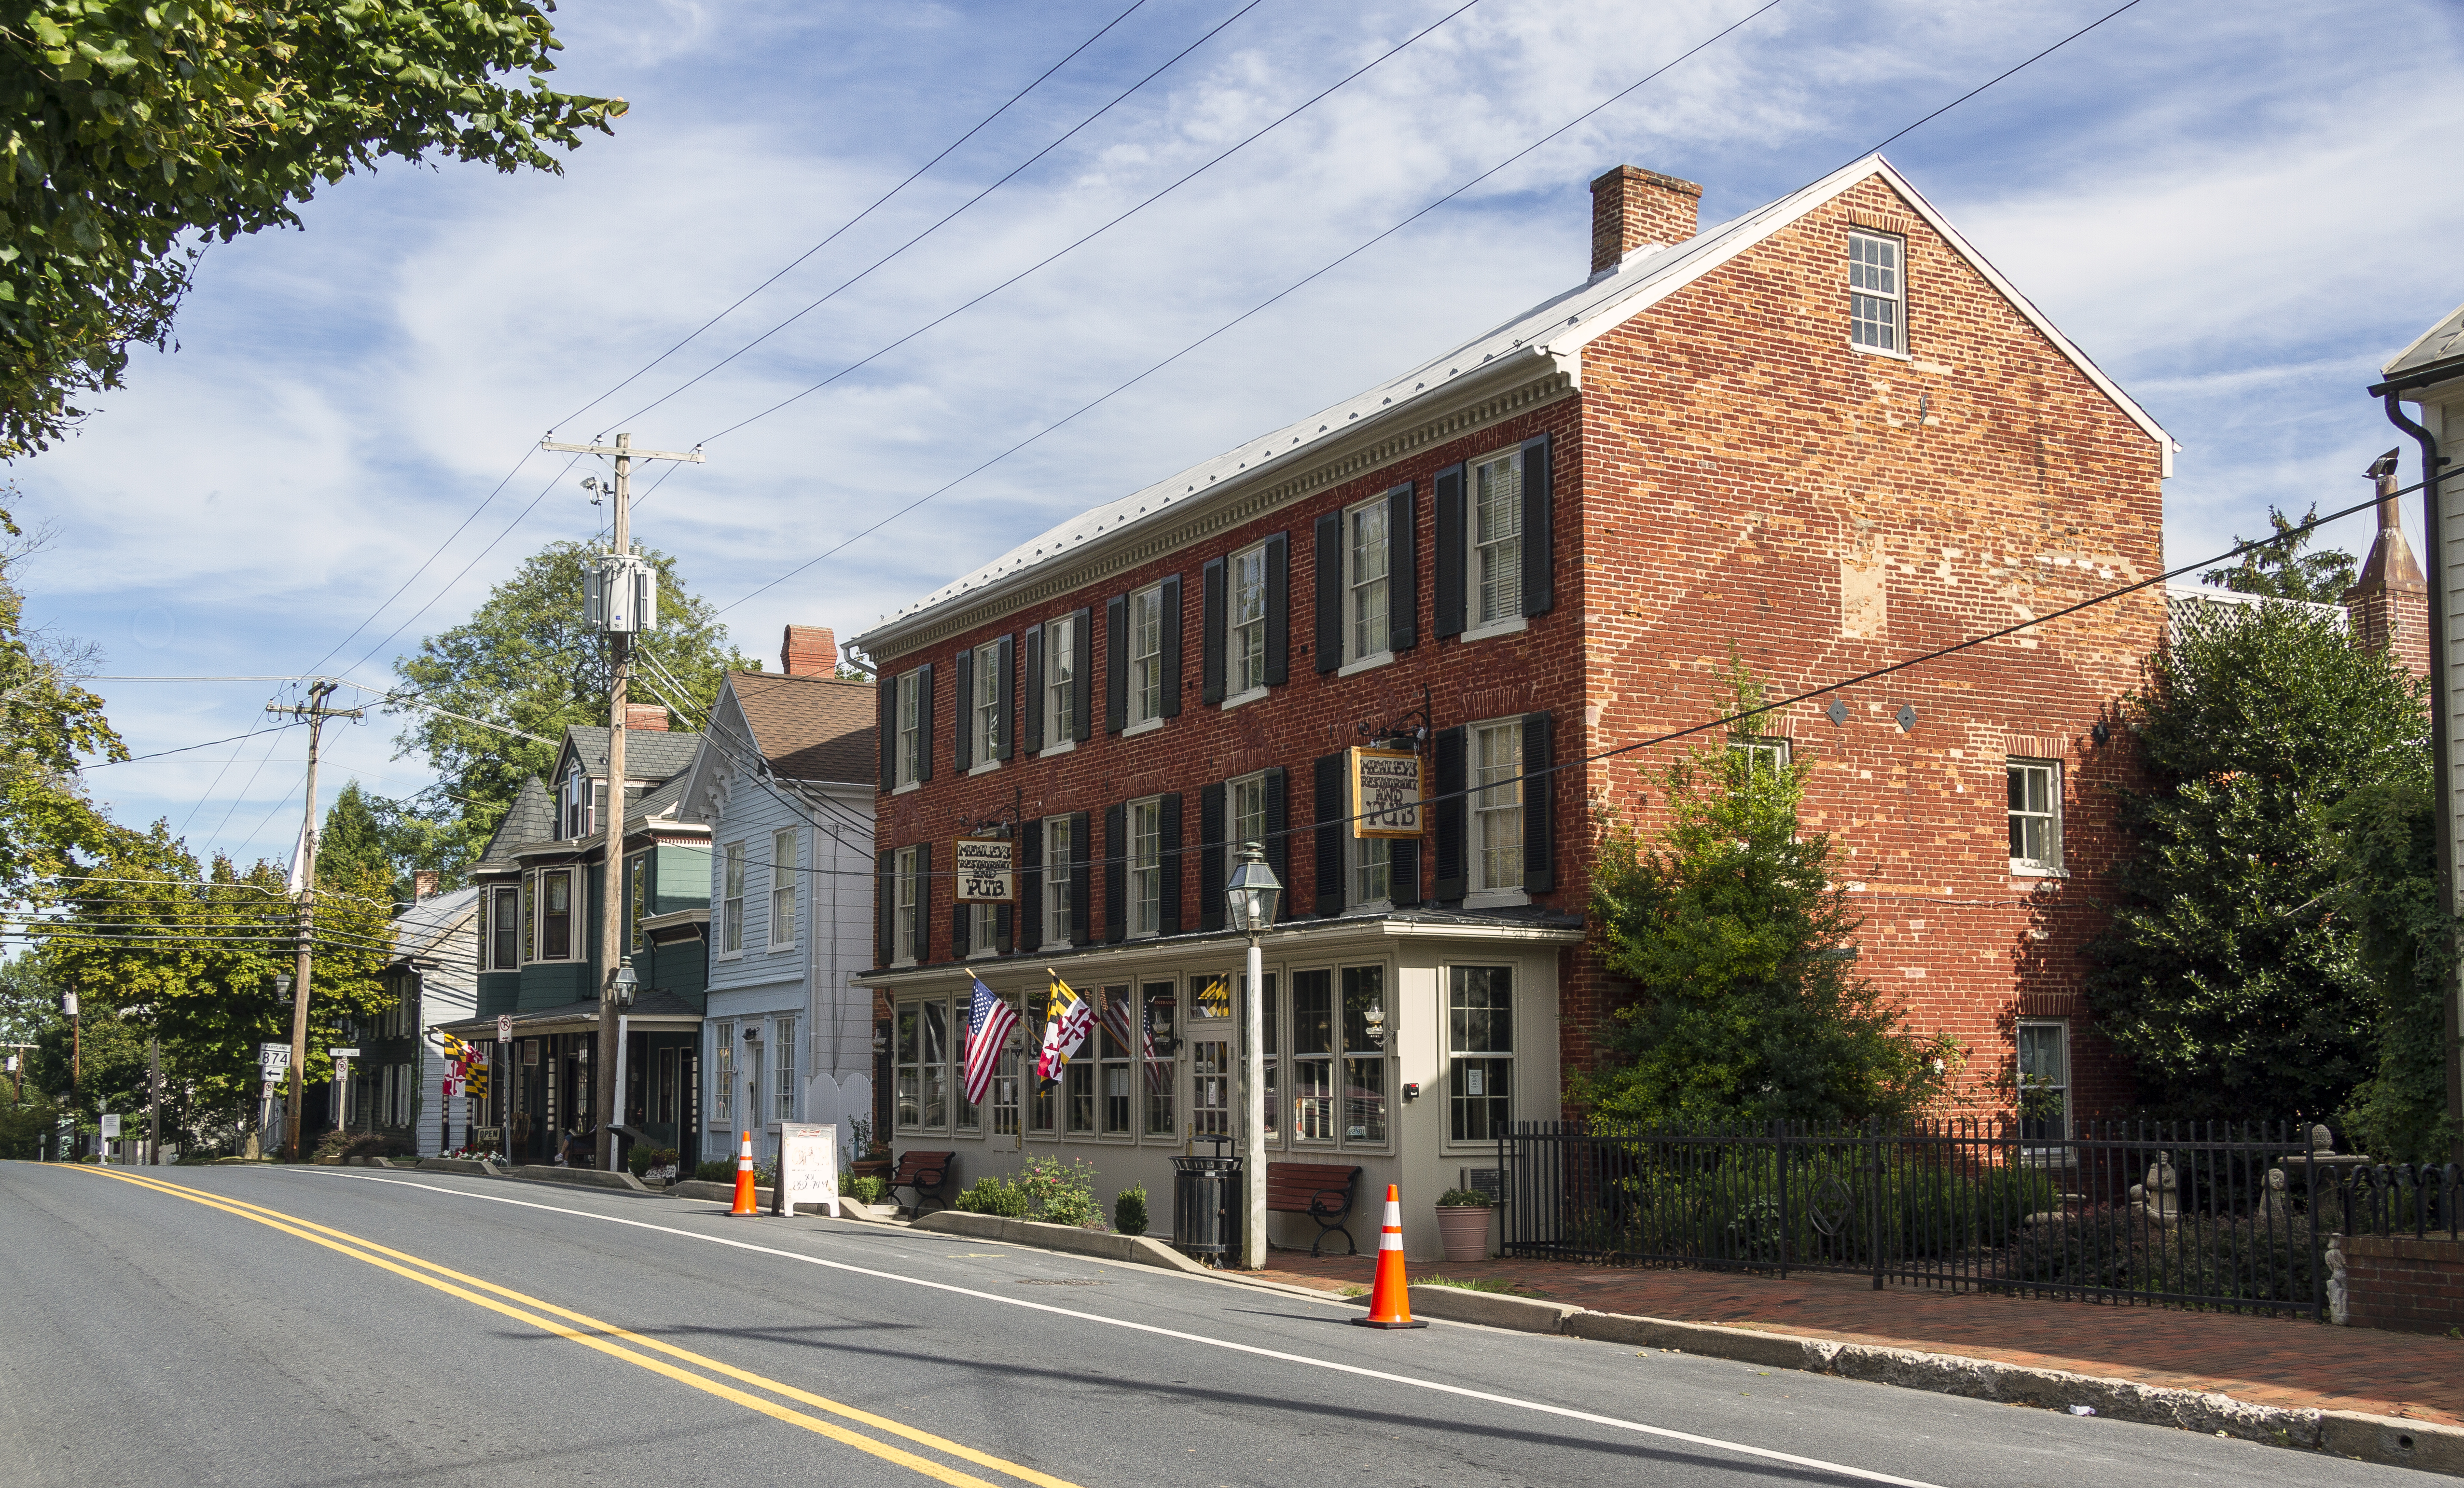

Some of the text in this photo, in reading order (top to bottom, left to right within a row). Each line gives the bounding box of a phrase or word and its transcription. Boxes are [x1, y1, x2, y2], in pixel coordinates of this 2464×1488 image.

[1361, 775, 1418, 791] RESTAURANT
[1375, 788, 1403, 803] AND
[1366, 800, 1415, 827] PUB
[958, 859, 1011, 869] RESTAURANT
[973, 868, 997, 879] AND
[262, 1052, 288, 1065] 874
[479, 1130, 498, 1138] OPEN
